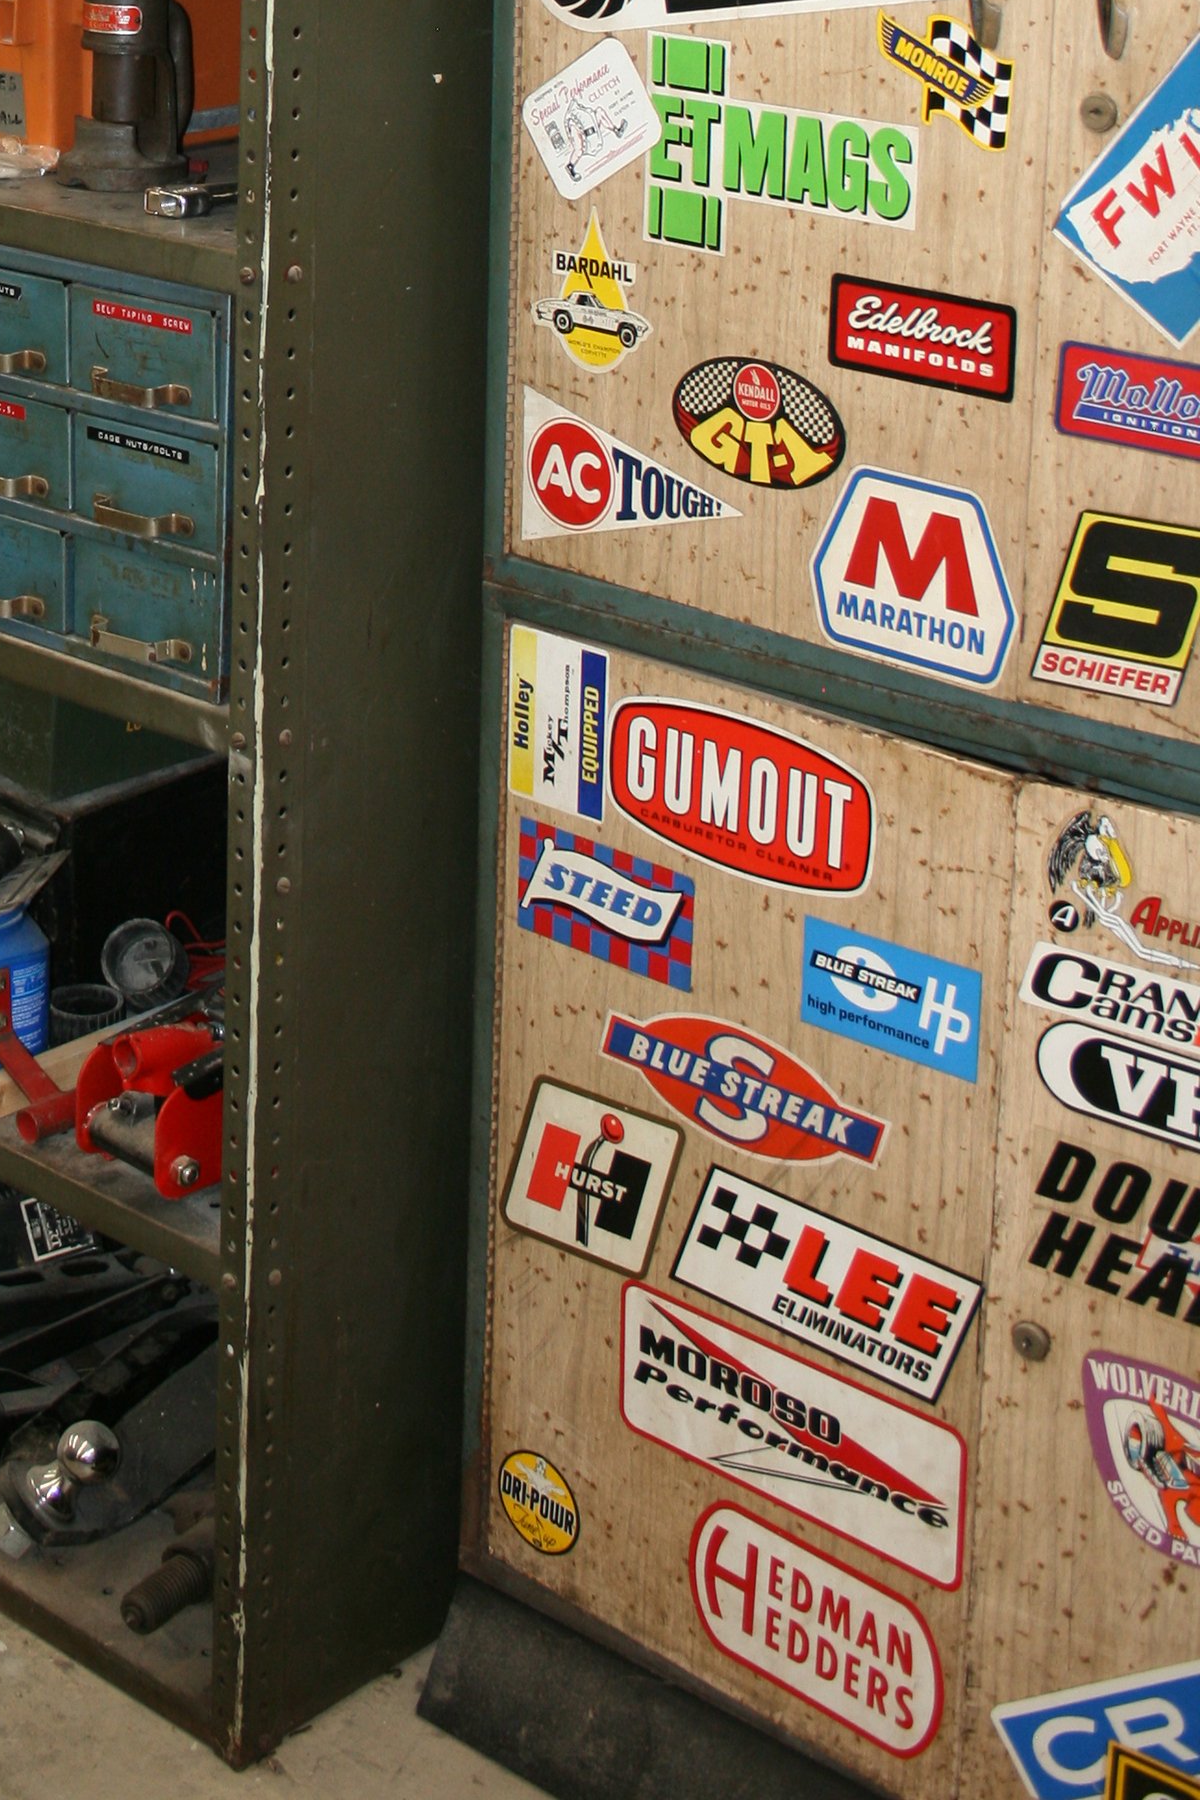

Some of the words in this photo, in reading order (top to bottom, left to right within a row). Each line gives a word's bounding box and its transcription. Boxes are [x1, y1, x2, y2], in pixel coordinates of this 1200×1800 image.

[530, 98, 561, 127] Special
[559, 62, 611, 104] Performance
[587, 75, 622, 104] CLUTCH
[893, 34, 971, 99] MONROE
[723, 104, 913, 219] MAGS
[1167, 207, 1197, 241] WAYNE
[556, 253, 633, 285] BARDAHL
[95, 302, 117, 317] SELF
[120, 307, 154, 324] TAPING
[162, 316, 192, 332] SCREW
[847, 295, 993, 358] Edelbrock
[846, 335, 995, 378] MANIFOLDS
[738, 382, 776, 402] KENDALL
[741, 398, 759, 409] MOTOR
[760, 401, 772, 411] OILS
[1103, 410, 1198, 439] IGNITION
[98, 430, 121, 445] CAGE
[125, 436, 183, 461] NUTS/BOLTS
[537, 443, 602, 502] AC
[611, 448, 722, 521] TOUGH!
[844, 496, 980, 618] M
[836, 590, 986, 656] MARATHON
[1040, 651, 1173, 697] SCHIEFER
[513, 677, 535, 751] Holley
[581, 685, 600, 785] EQUIPPED
[626, 715, 853, 870] GUMOUT
[640, 806, 749, 853] CARBURETOR
[754, 845, 834, 883] CLEANER
[543, 862, 664, 926] STEED
[814, 954, 854, 981] BLUE
[855, 967, 919, 1002] STREAK
[806, 993, 837, 1020] high
[837, 1007, 931, 1051] performance
[628, 1035, 713, 1084] BLUE
[718, 1070, 855, 1146] STREAK
[555, 1161, 628, 1204] HURST
[1035, 1140, 1200, 1243] DOU
[784, 1224, 962, 1358] LEE
[772, 1293, 933, 1384] ELIMINATORS
[639, 1324, 841, 1449] MOROSO
[633, 1360, 950, 1530] Performance
[501, 1469, 575, 1538] DRI-POWR
[1106, 1479, 1163, 1547] SPEED
